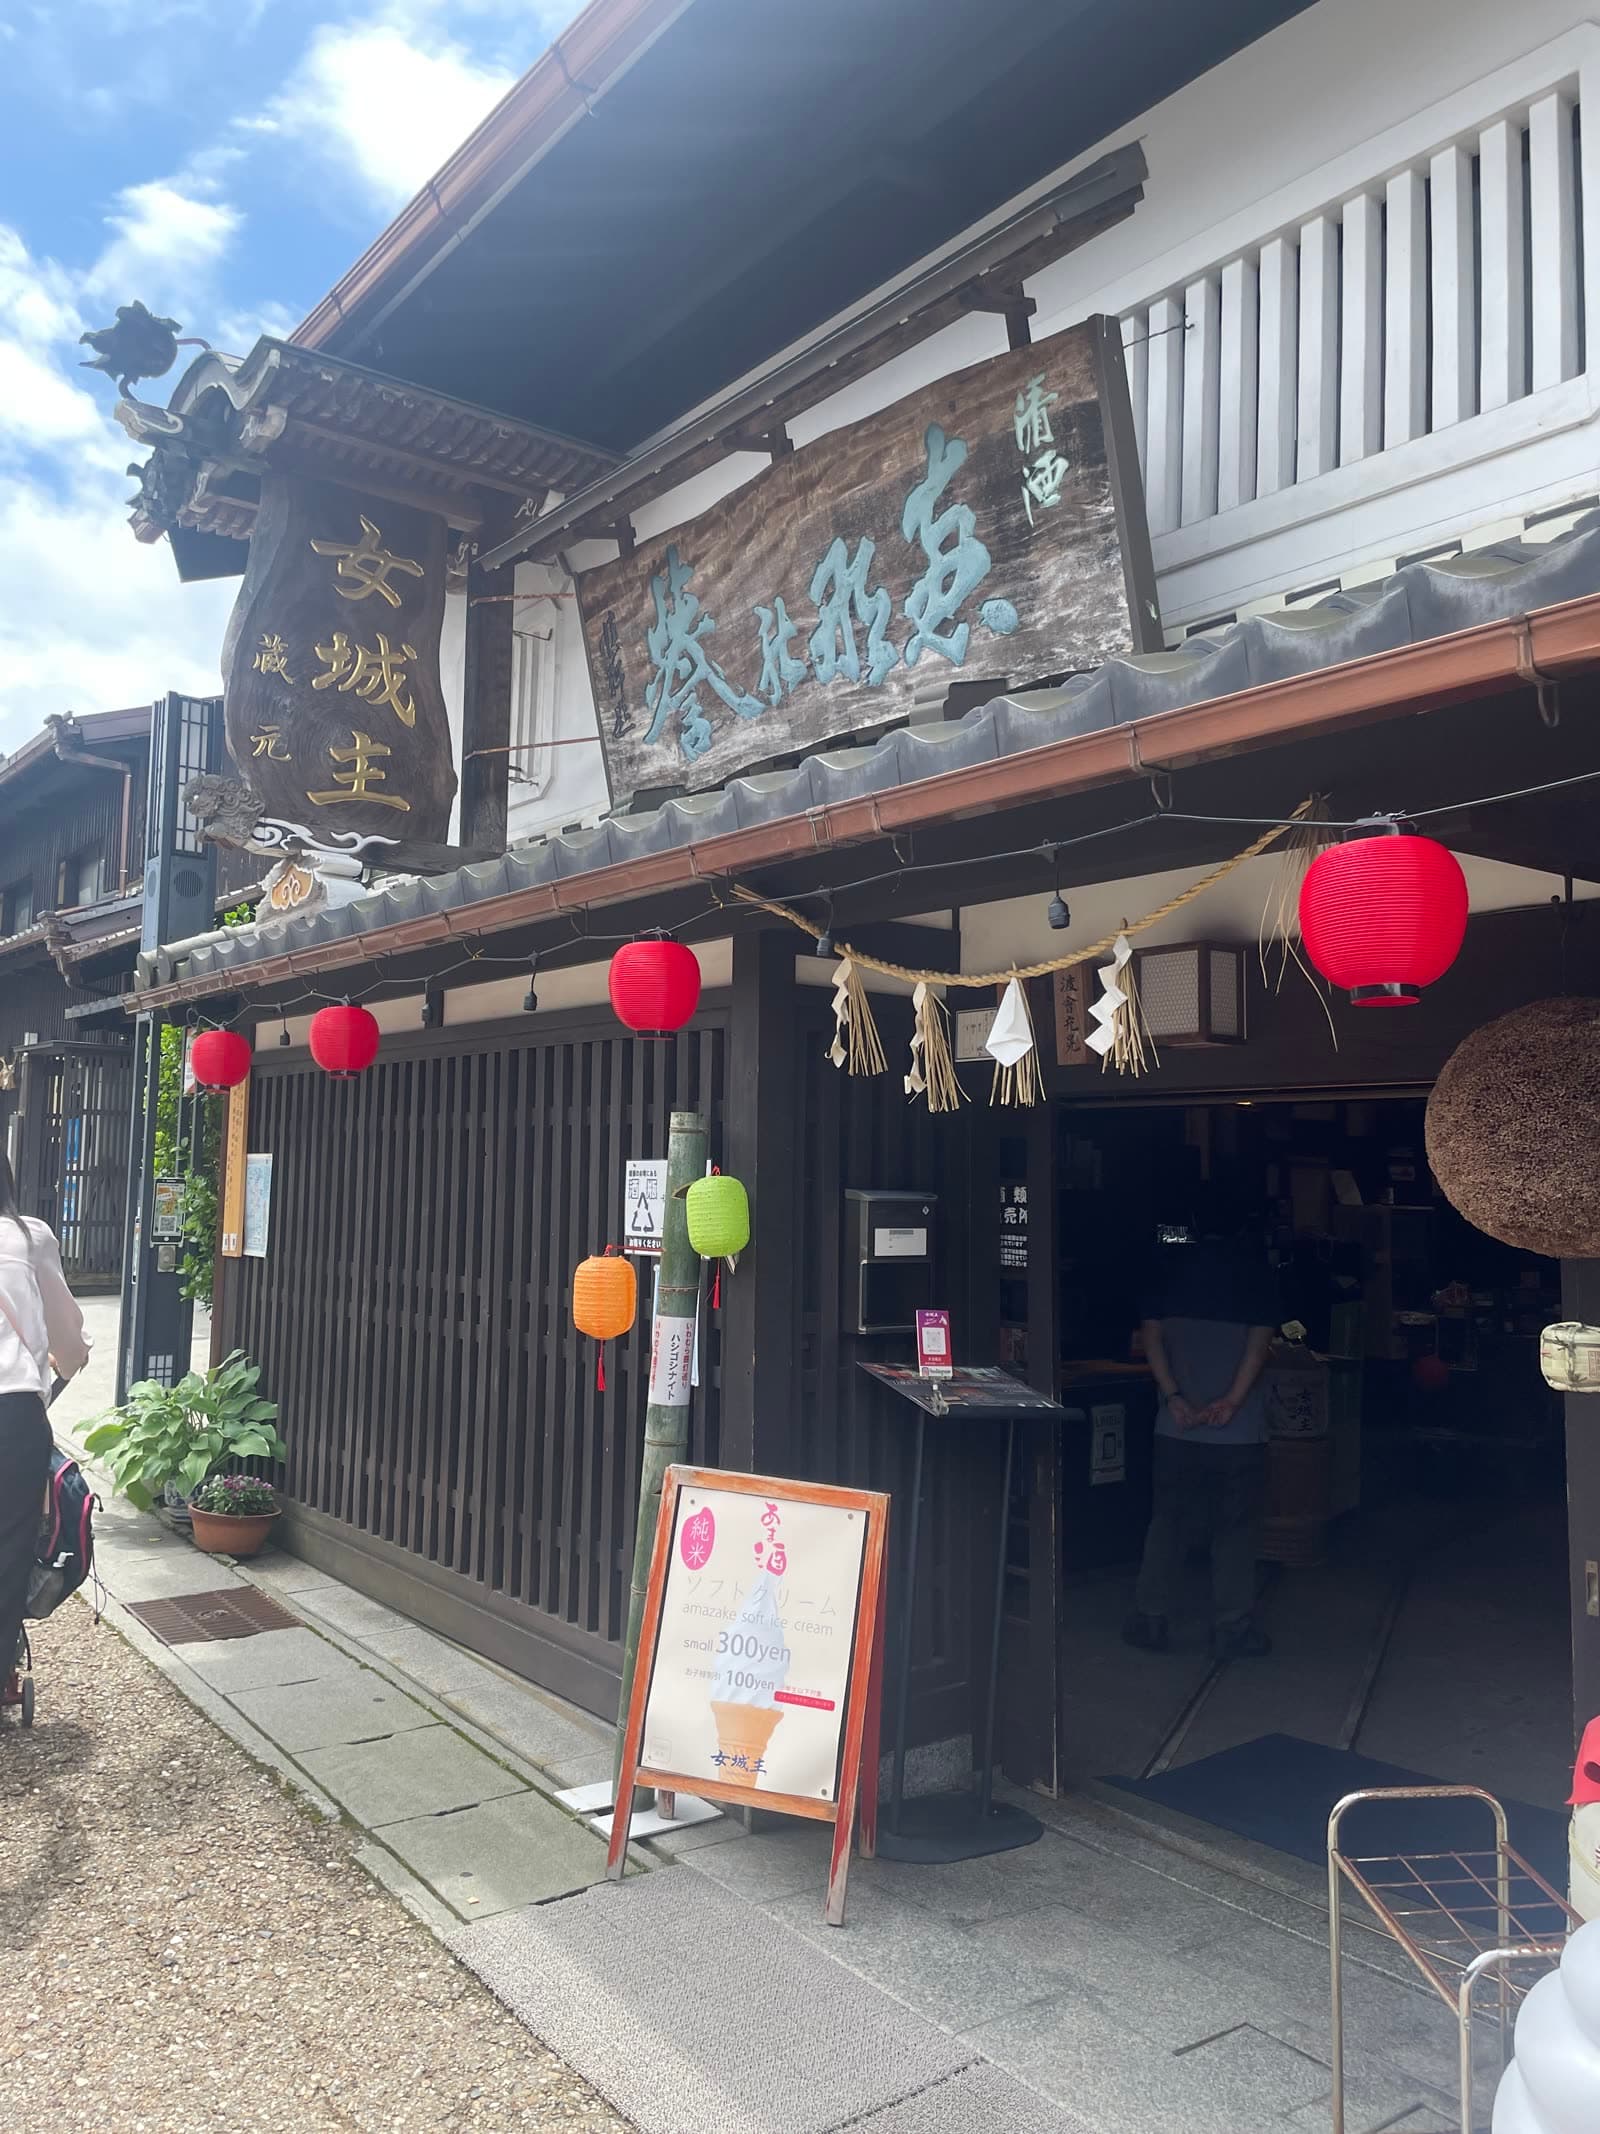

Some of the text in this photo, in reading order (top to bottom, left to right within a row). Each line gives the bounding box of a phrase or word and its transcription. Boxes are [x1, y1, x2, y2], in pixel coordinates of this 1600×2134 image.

[1013, 371, 1070, 528] 清酒
[307, 514, 424, 812] 女城主
[250, 634, 297, 763] 蔵元
[667, 1334, 680, 1400] ハシゴシナイト
[687, 1517, 710, 1566] 純米
[754, 1502, 787, 1576] あま酒
[682, 1603, 834, 1636] amazake soft ice cream
[688, 1576, 837, 1617] ソフトクリーム
[683, 1631, 791, 1663] small 300yen
[726, 1669, 775, 1691] 100yen
[711, 1750, 767, 1774] 女城主
